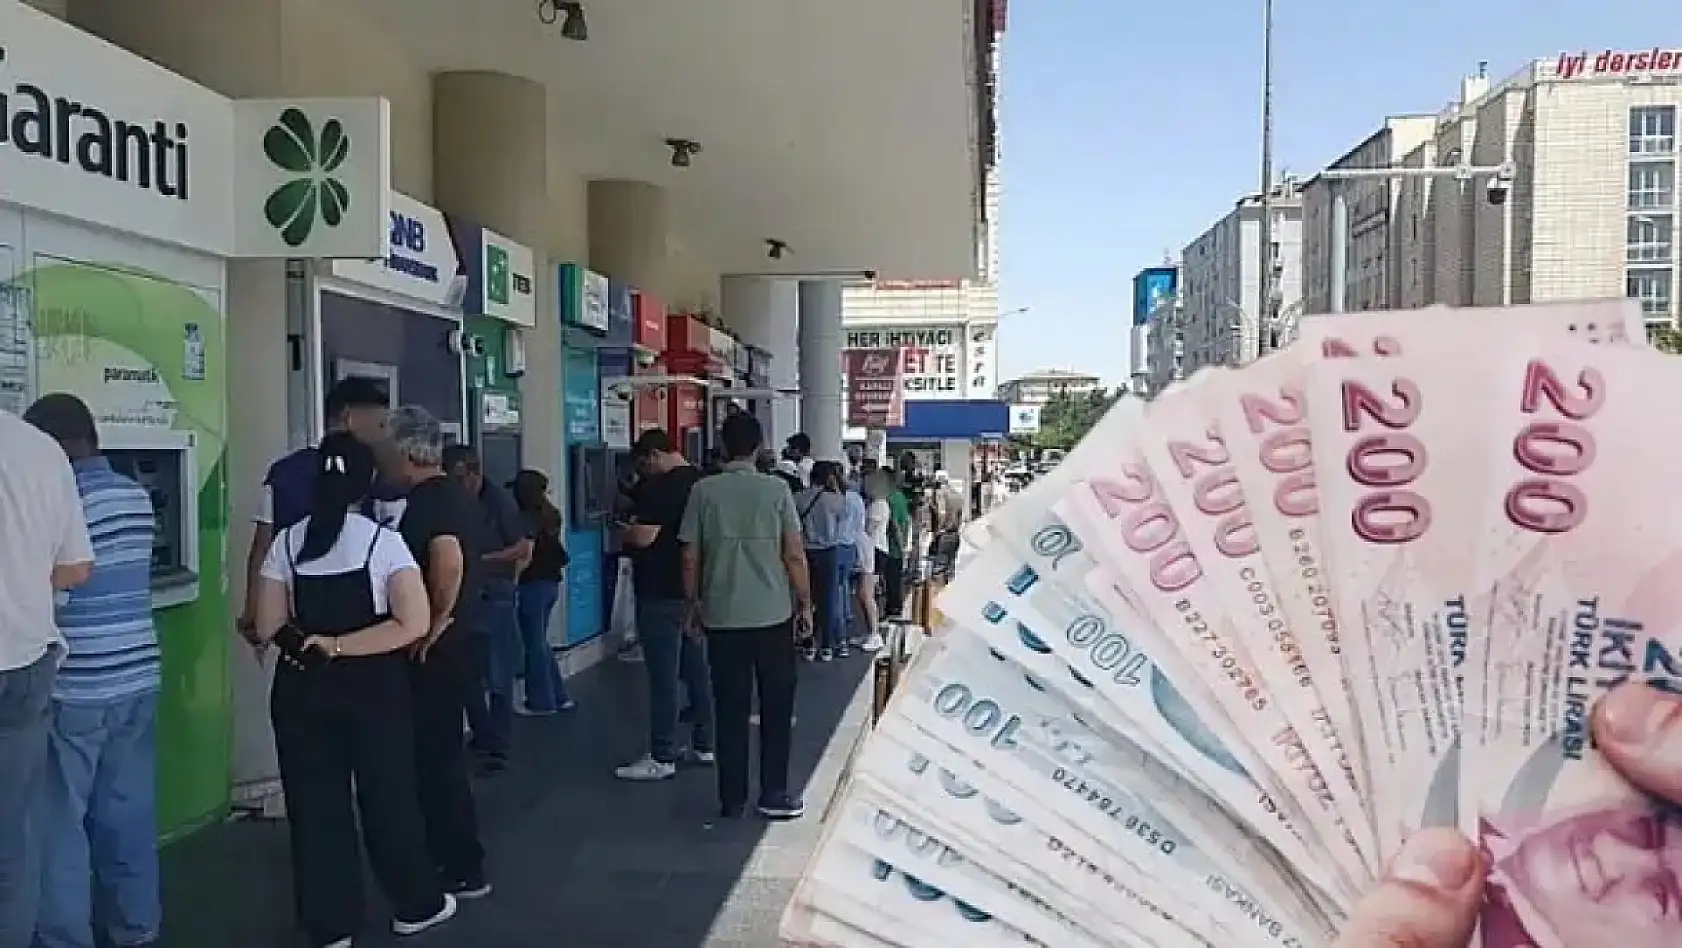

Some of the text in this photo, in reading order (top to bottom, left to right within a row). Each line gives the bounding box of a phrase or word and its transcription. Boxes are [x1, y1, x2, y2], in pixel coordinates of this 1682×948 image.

[1556, 51, 1587, 79] iyi
[848, 333, 880, 347] HER
[1168, 422, 1261, 560] 200
[1241, 385, 1321, 519] 200
[1341, 375, 1433, 545] 200
[1503, 359, 1607, 535] 200
[1089, 462, 1204, 594] 200
[934, 682, 1022, 750] 100
[1066, 614, 1148, 687] 100
